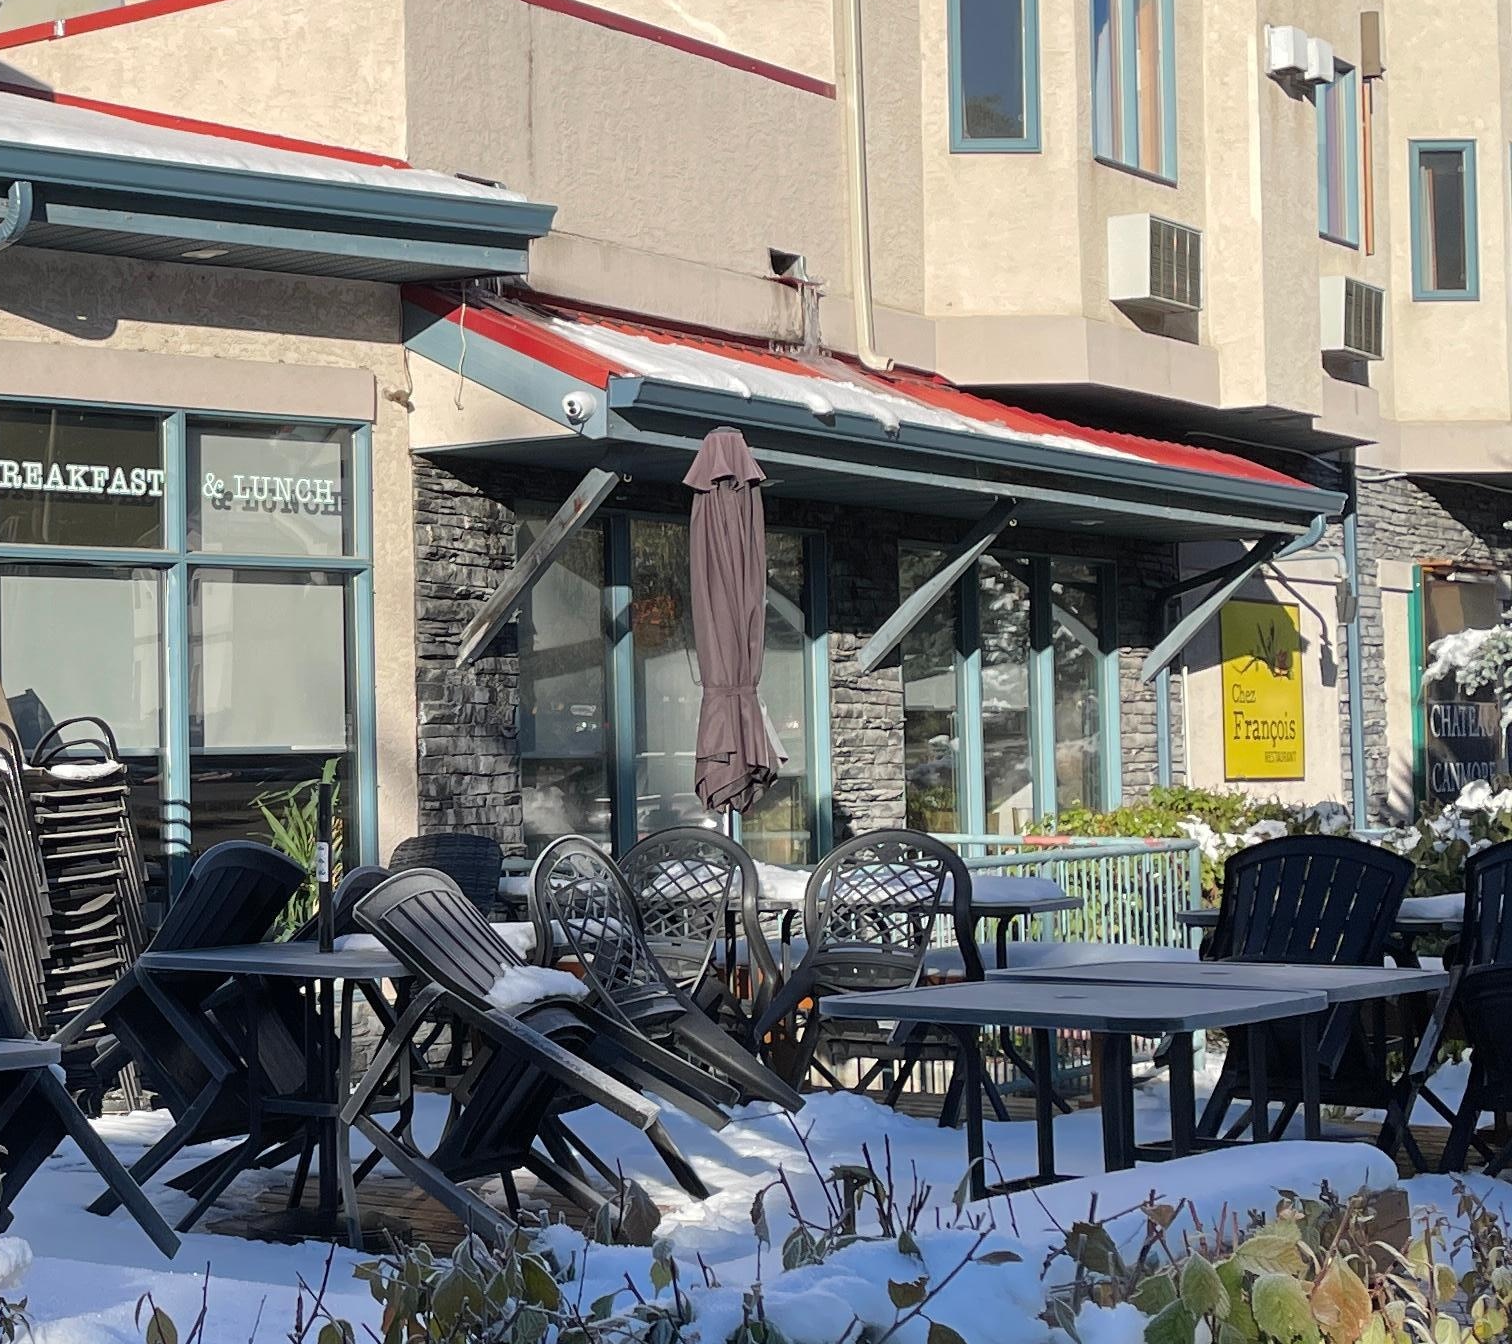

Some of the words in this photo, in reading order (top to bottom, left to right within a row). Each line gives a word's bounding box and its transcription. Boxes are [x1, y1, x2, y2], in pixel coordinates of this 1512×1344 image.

[202, 472, 225, 499] &
[232, 474, 335, 505] LUNCH
[1231, 683, 1257, 704] Chez
[1232, 710, 1297, 748] François
